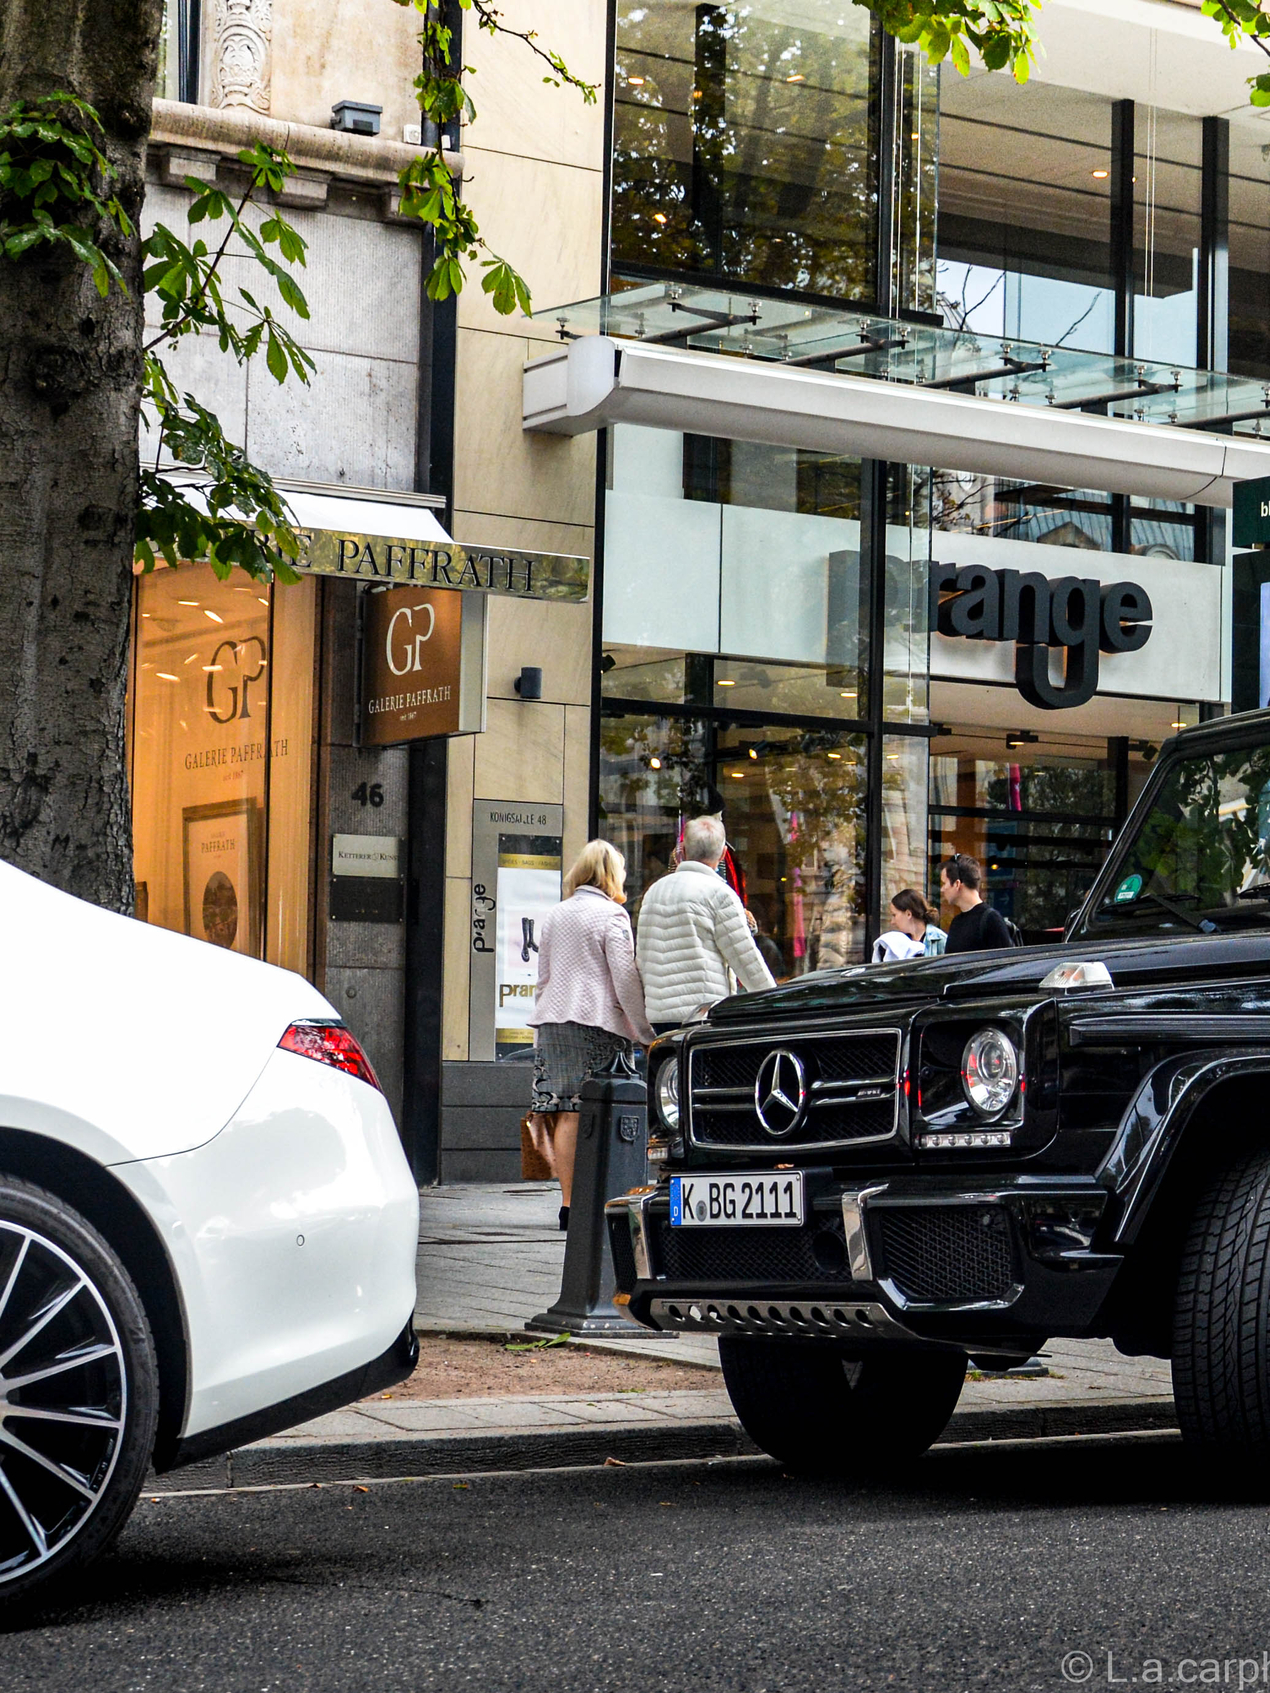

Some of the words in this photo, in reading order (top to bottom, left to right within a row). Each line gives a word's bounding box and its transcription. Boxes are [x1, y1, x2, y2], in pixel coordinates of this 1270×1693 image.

[336, 539, 536, 593] PAFFRATH
[368, 694, 404, 714] GALERIE
[406, 685, 451, 708] PAFFRATH
[184, 747, 227, 770] GALERIE
[351, 781, 384, 808] 46
[537, 814, 547, 826] 48
[682, 1183, 695, 1220] K
[708, 1182, 737, 1220] BG
[741, 1181, 797, 1219] 2111
